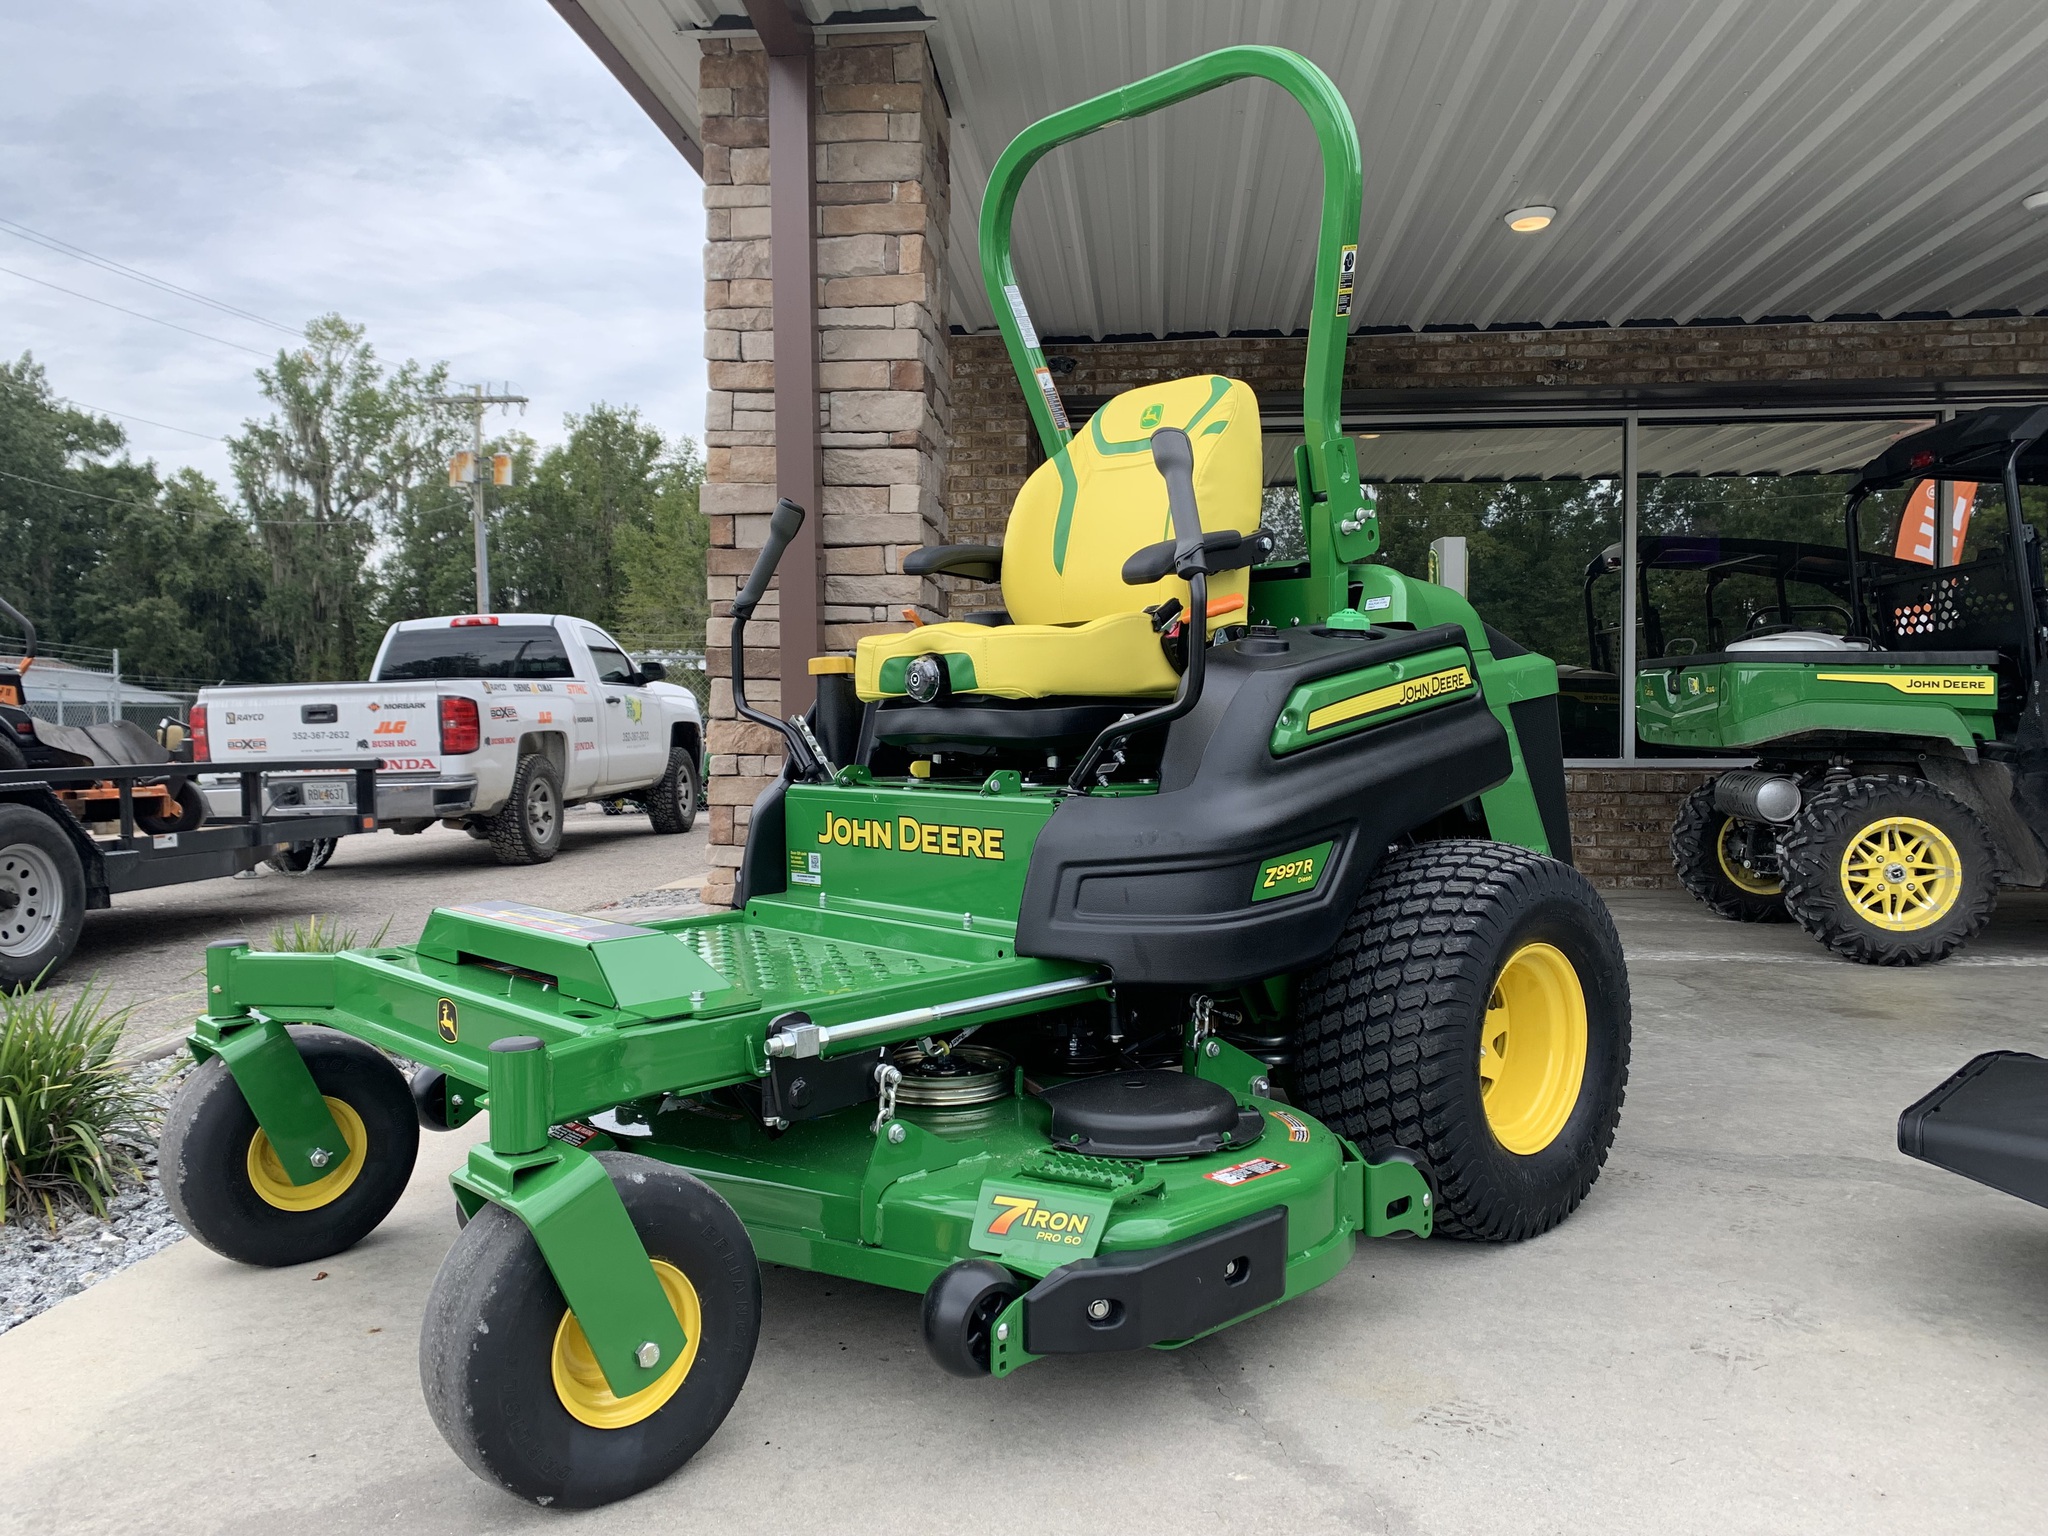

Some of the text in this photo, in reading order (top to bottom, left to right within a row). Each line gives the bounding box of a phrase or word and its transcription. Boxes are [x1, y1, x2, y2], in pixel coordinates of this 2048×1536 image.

[566, 684, 588, 694] STIHL
[1400, 673, 1465, 704] JOHN DEERE
[1906, 679, 1986, 689] JOHN DEERE
[383, 702, 426, 710] MORBARK
[236, 713, 265, 721] RAYCO
[490, 707, 517, 718] BOXER
[373, 721, 407, 735] JLG
[292, 731, 350, 740] 352-367-2632
[227, 739, 267, 750] BOXER
[371, 739, 417, 748] BUSH HOG
[818, 810, 1005, 861] JOHN DEERE
[1262, 857, 1315, 890] Z997R
[987, 1194, 1091, 1236] 7 IRON
[1035, 1231, 1082, 1246] PRO 60
